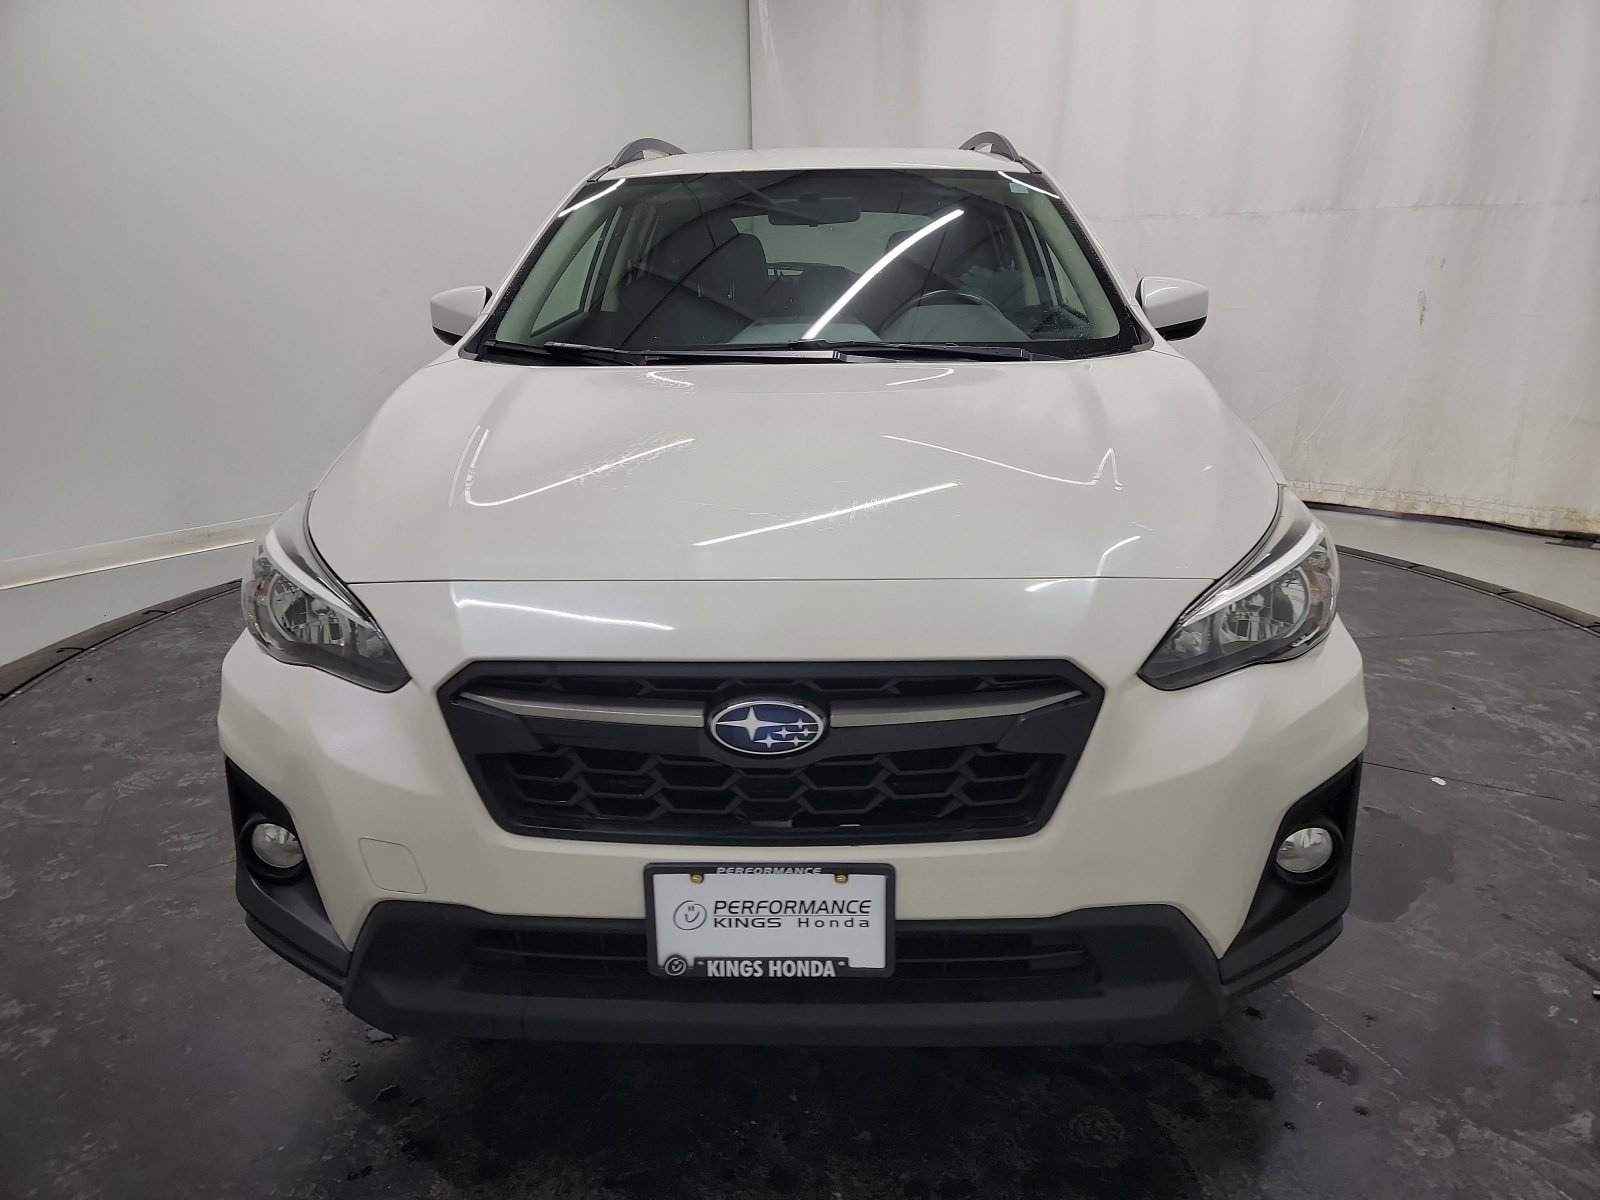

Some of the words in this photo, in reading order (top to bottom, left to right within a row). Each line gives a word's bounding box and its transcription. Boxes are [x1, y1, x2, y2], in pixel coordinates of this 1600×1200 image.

[716, 867, 822, 875] PERFORMANCE
[713, 900, 872, 915] PERFORMANCE
[713, 917, 782, 928] KINGS
[798, 917, 870, 928] Honda
[707, 960, 764, 977] KINGS
[768, 960, 836, 977] HONDA
